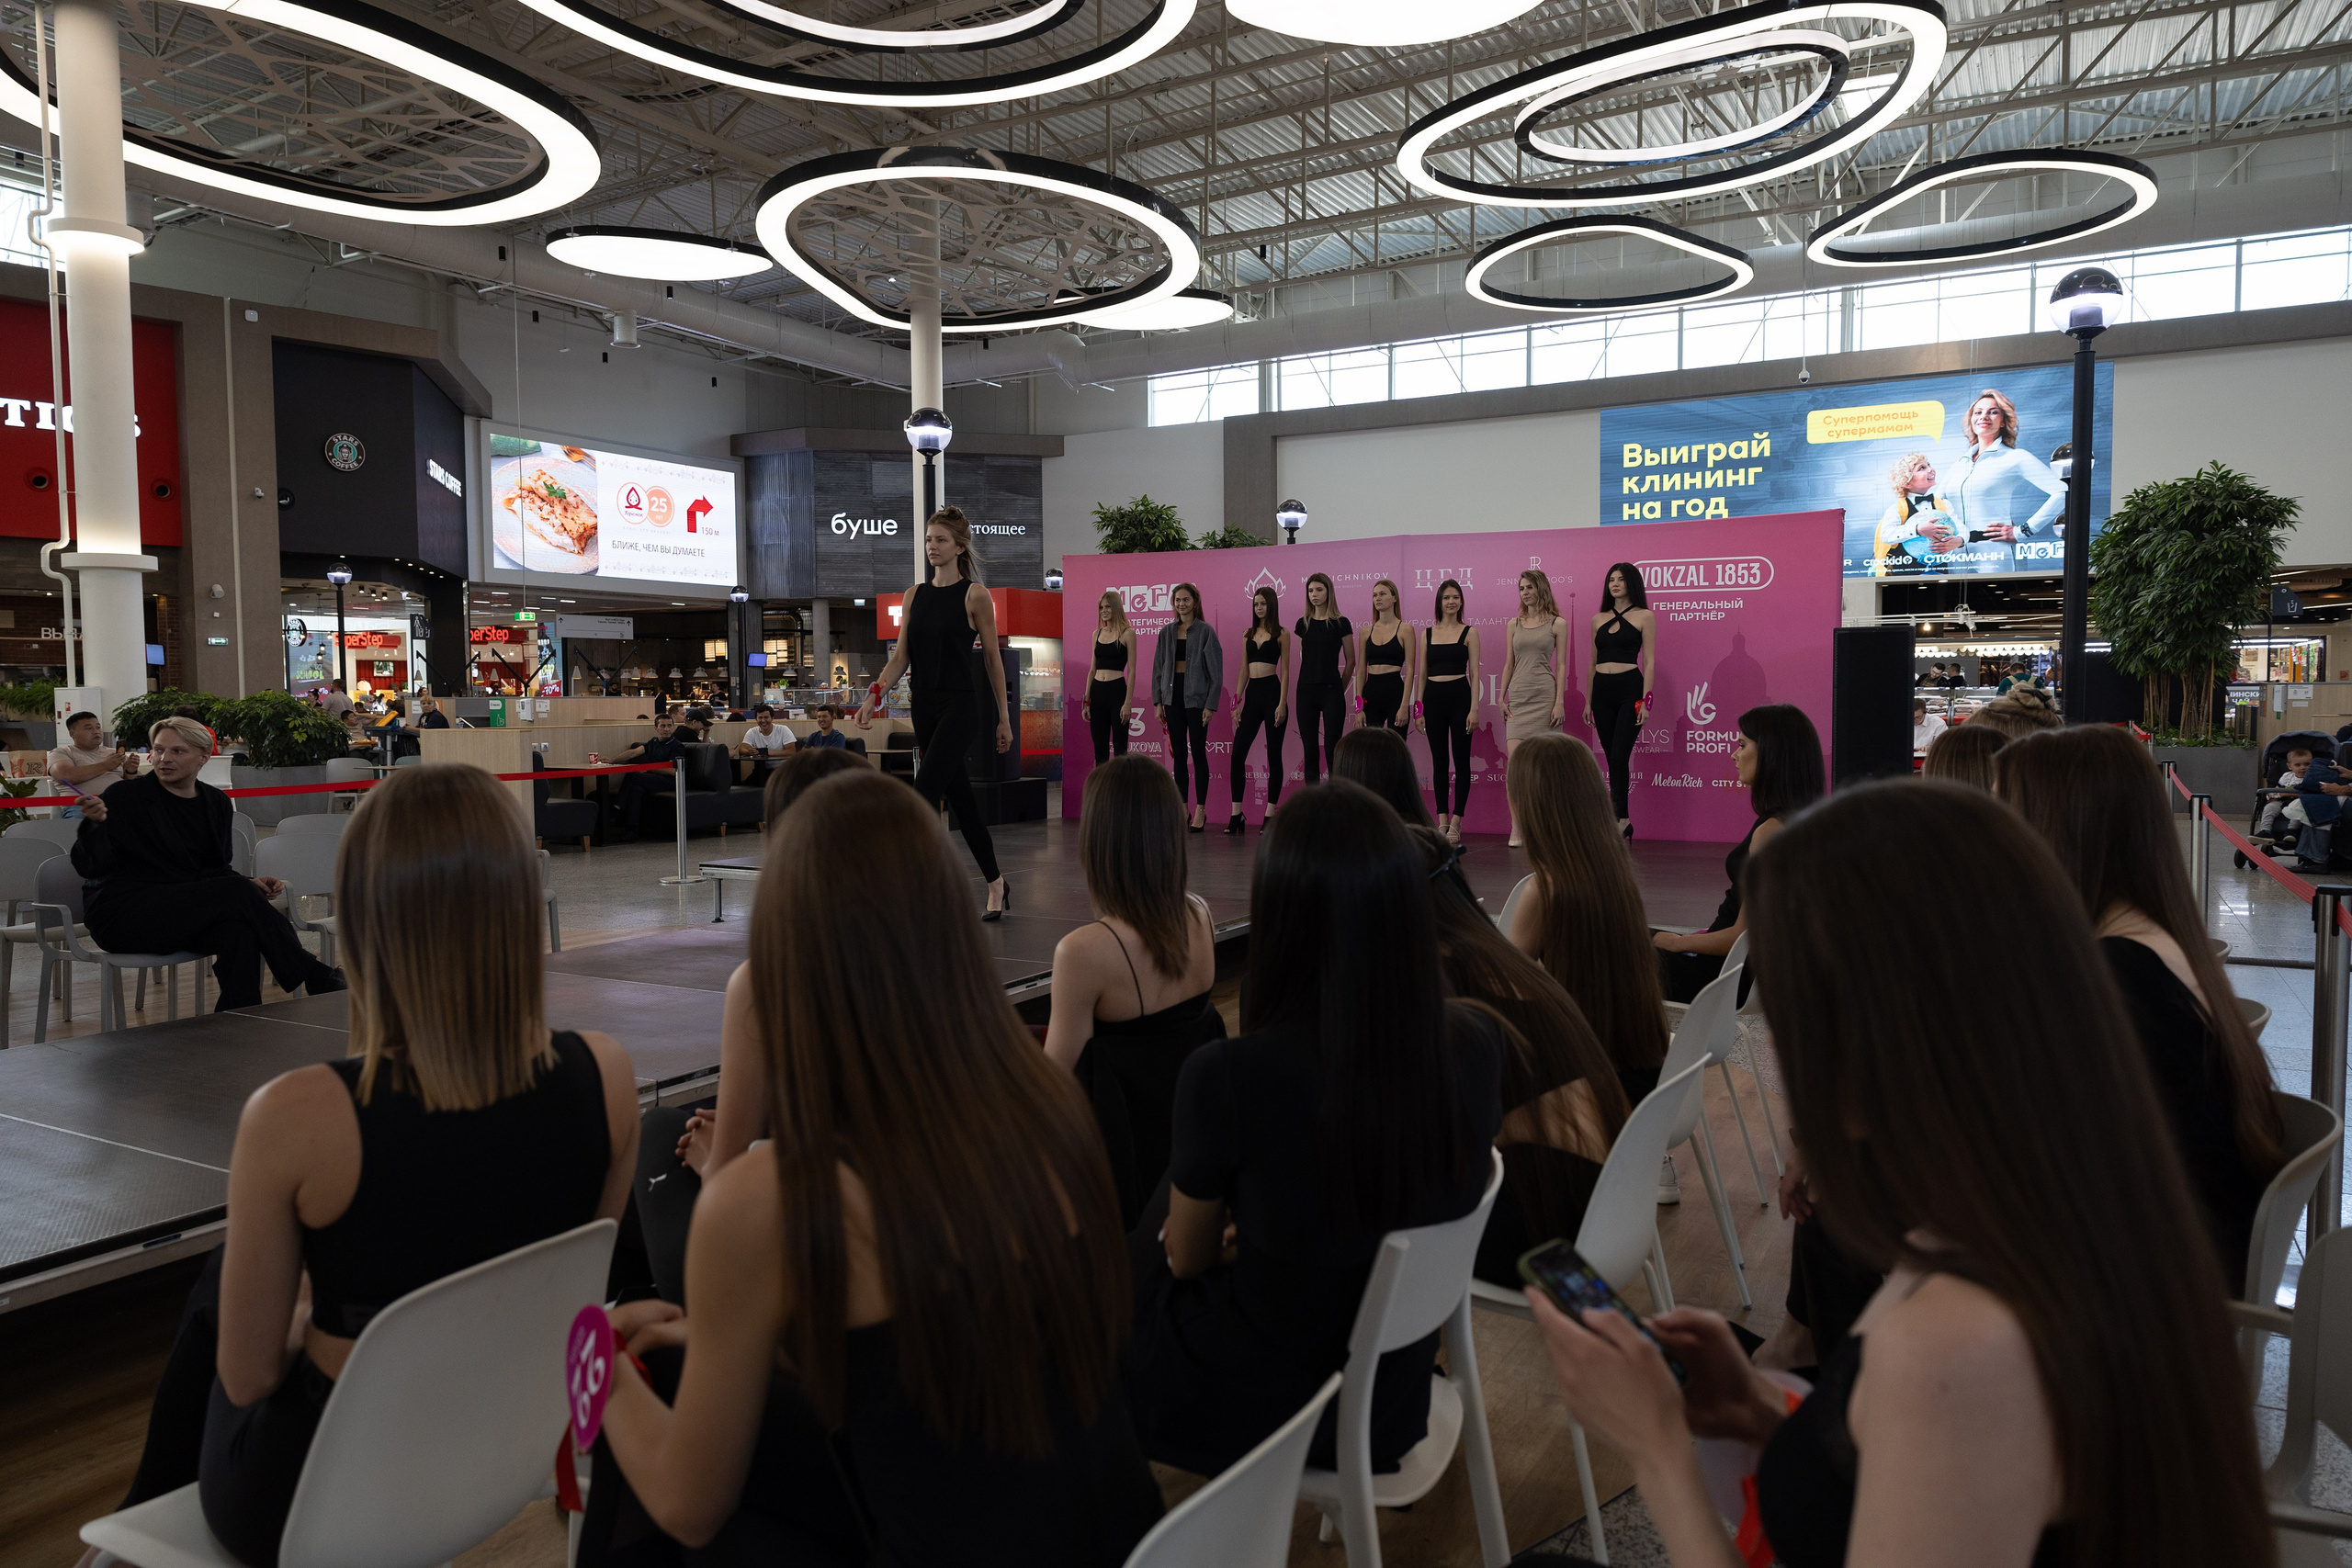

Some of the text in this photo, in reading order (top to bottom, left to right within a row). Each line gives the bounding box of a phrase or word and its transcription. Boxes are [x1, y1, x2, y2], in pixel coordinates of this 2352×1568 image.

[1823, 411, 1919, 425] Суперпомощь
[1827, 423, 1914, 439] супермамам
[332, 434, 359, 446] STARS
[1623, 432, 1770, 468] Выиграй
[332, 458, 359, 469] COFFEE
[1623, 467, 1763, 494] клининг
[650, 496, 668, 513] 25
[1623, 497, 1729, 520] на год
[701, 526, 713, 536] 150
[831, 512, 898, 539] буше
[969, 524, 1026, 536] стоящее
[612, 540, 705, 557] БЛИЖЕ, ЧЕМ ВЫ ДУМАЕТЕ
[1863, 556, 1903, 566] crockid
[1640, 562, 1761, 588] VOKZAL 1853
[1653, 597, 1744, 611] ГЕНЕРАЛЬНЫЙ
[1129, 617, 1175, 626] ТЕГИЧЕСК
[1669, 610, 1725, 621] ПАРТНЁР
[334, 632, 382, 649] SperStep
[1686, 730, 1740, 742] FORMU
[1686, 742, 1731, 753] PROFI
